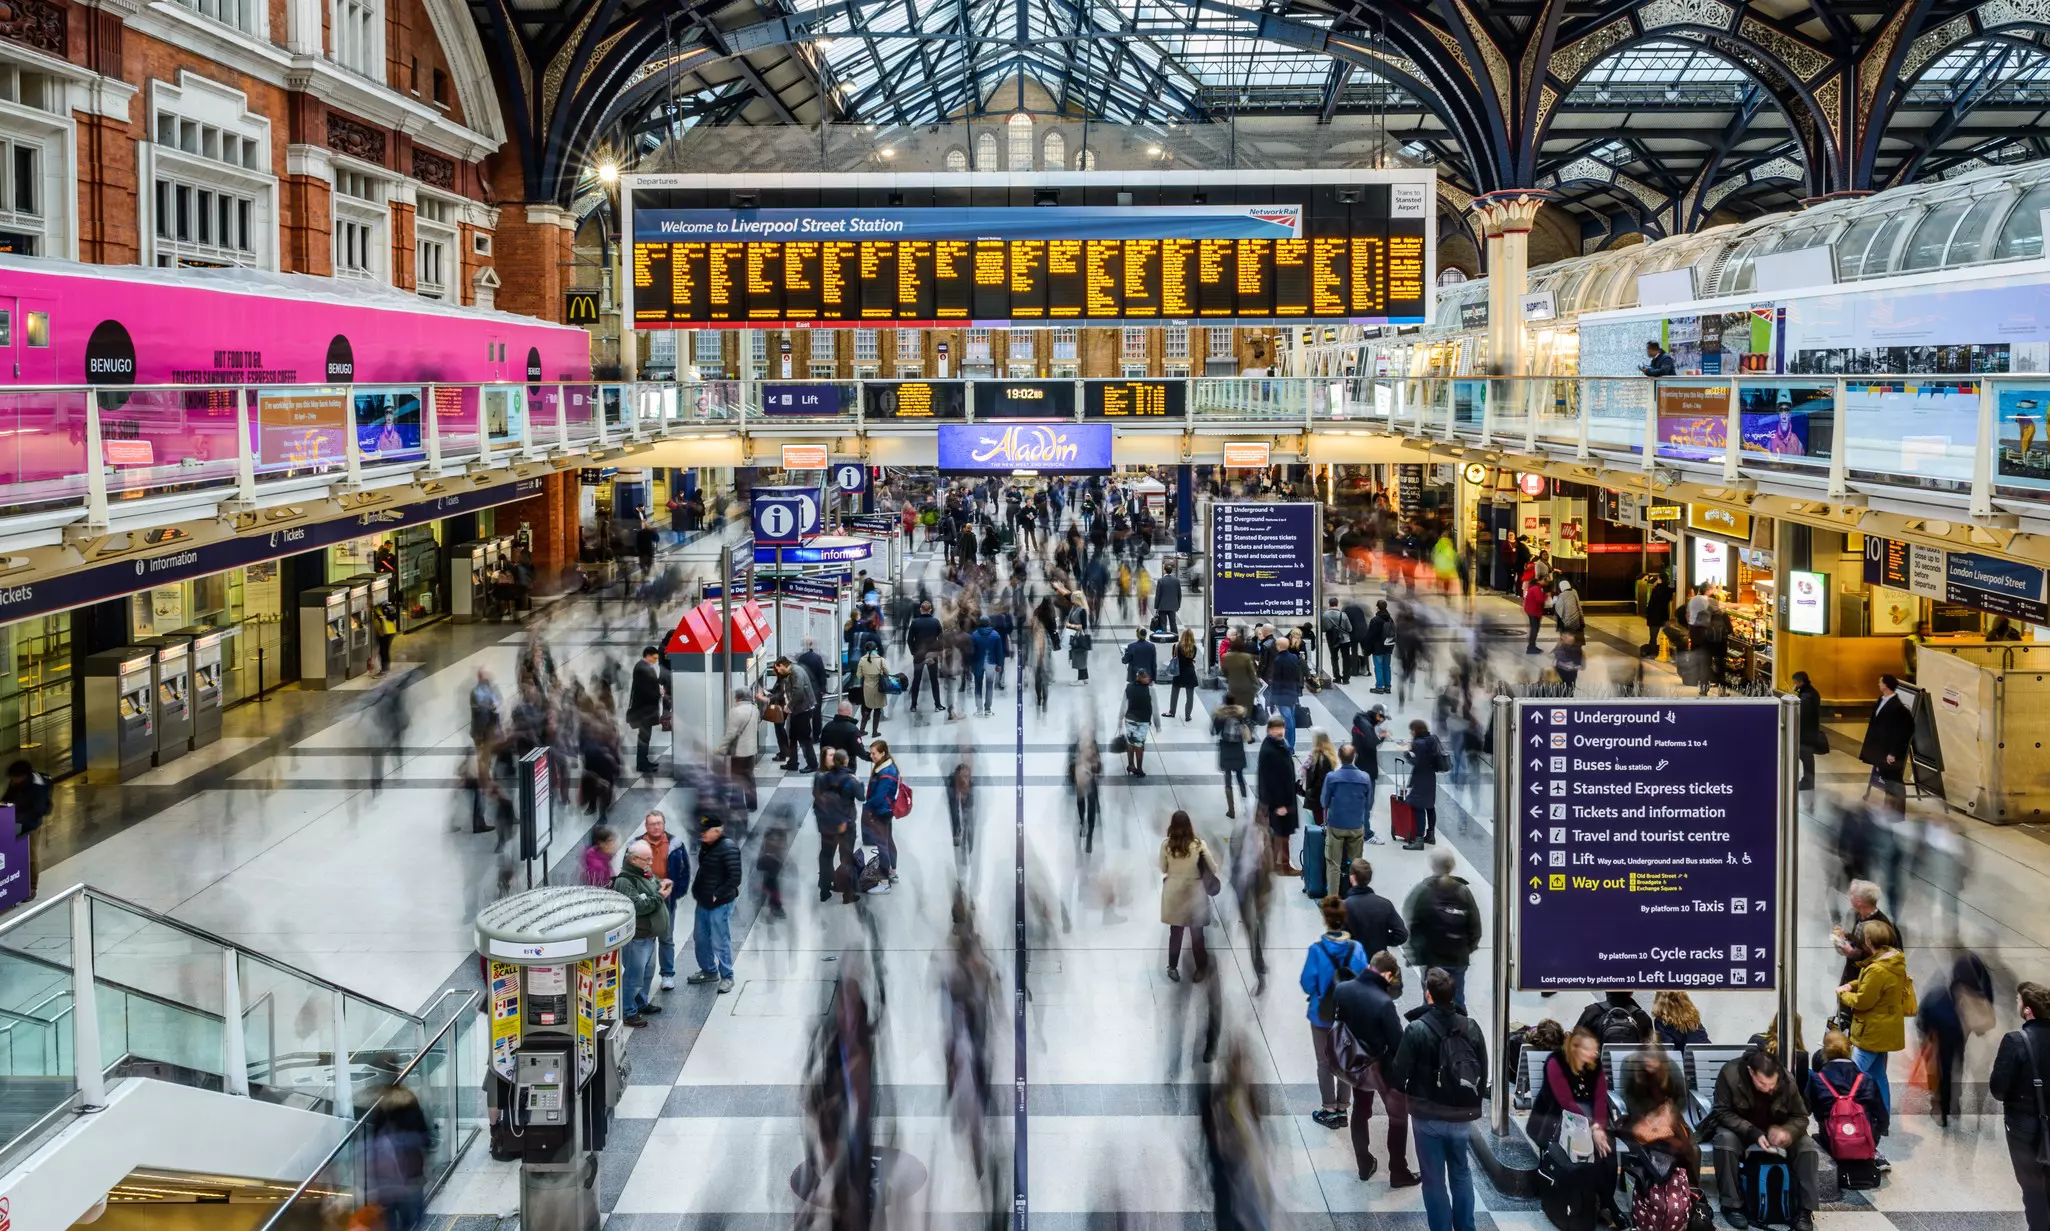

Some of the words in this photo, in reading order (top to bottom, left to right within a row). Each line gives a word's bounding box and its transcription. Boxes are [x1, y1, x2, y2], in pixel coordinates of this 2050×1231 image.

[637, 178, 678, 186] Departures
[661, 220, 714, 233] Welcome
[716, 222, 728, 233] to
[731, 218, 798, 236] Liverpool
[801, 218, 846, 232] Street
[850, 218, 904, 232] Station
[90, 358, 132, 372] BENUGO
[214, 350, 226, 368] HOT
[228, 351, 243, 368] FOOD
[244, 352, 252, 368] TO
[328, 362, 352, 375] BENUGO
[528, 367, 540, 376] BENUGO
[802, 395, 818, 404] Lift
[1006, 388, 1034, 399] 19:02
[971, 426, 1078, 462] Aladdin
[446, 496, 459, 506] Tickets
[1234, 506, 1268, 514] Underground
[1526, 518, 1536, 528] illy
[282, 528, 305, 542] Tickets
[1562, 526, 1576, 538] illy
[821, 548, 868, 560] information
[1864, 536, 1881, 562] 10
[150, 551, 198, 572] Information
[1914, 552, 1927, 560] close
[1928, 555, 1934, 563] up
[1950, 555, 1968, 565] Welcome
[1914, 560, 1920, 569] 30
[1921, 563, 1941, 573] seconds
[1914, 571, 1929, 580] before
[1950, 564, 1973, 578] London
[1974, 570, 2004, 586] Liverpool
[2005, 576, 2026, 590] Street
[803, 586, 823, 594] departures
[1914, 580, 1936, 591] departure
[0, 586, 32, 605] ickets
[1574, 710, 1660, 726] Underground
[1574, 734, 1652, 750] Overground
[1574, 758, 1612, 770] Buses
[1574, 782, 1632, 794] Stansted
[1636, 782, 1686, 798] Express
[1688, 782, 1733, 794] tickets
[1572, 806, 1618, 818] Tickets
[1622, 806, 1646, 818] and
[1649, 806, 1726, 818] information
[1572, 830, 1610, 842] Travel
[1613, 830, 1638, 842] and
[1641, 830, 1684, 842] tourist
[1688, 830, 1730, 842] centre
[1572, 852, 1595, 865] Lift
[1597, 858, 1612, 866] Way
[1627, 857, 1670, 866] Underground
[1572, 876, 1600, 892] Way
[1602, 877, 1626, 888] out
[1640, 905, 1650, 914] By
[1651, 905, 1680, 914] platform
[1692, 900, 1725, 912] Taxis
[608, 934, 616, 942] BT
[1598, 952, 1608, 962] By
[1608, 952, 1638, 962] platform
[1639, 952, 1648, 960] 10
[1651, 946, 1686, 962] Cycle
[1690, 946, 1724, 960] racks
[1541, 975, 1555, 984] Lost
[1556, 975, 1586, 986] property
[1587, 975, 1596, 986] by
[1596, 975, 1626, 985] platform
[1627, 975, 1636, 984] 10
[1638, 970, 1665, 983] Left
[1668, 970, 1724, 986] Luggage
